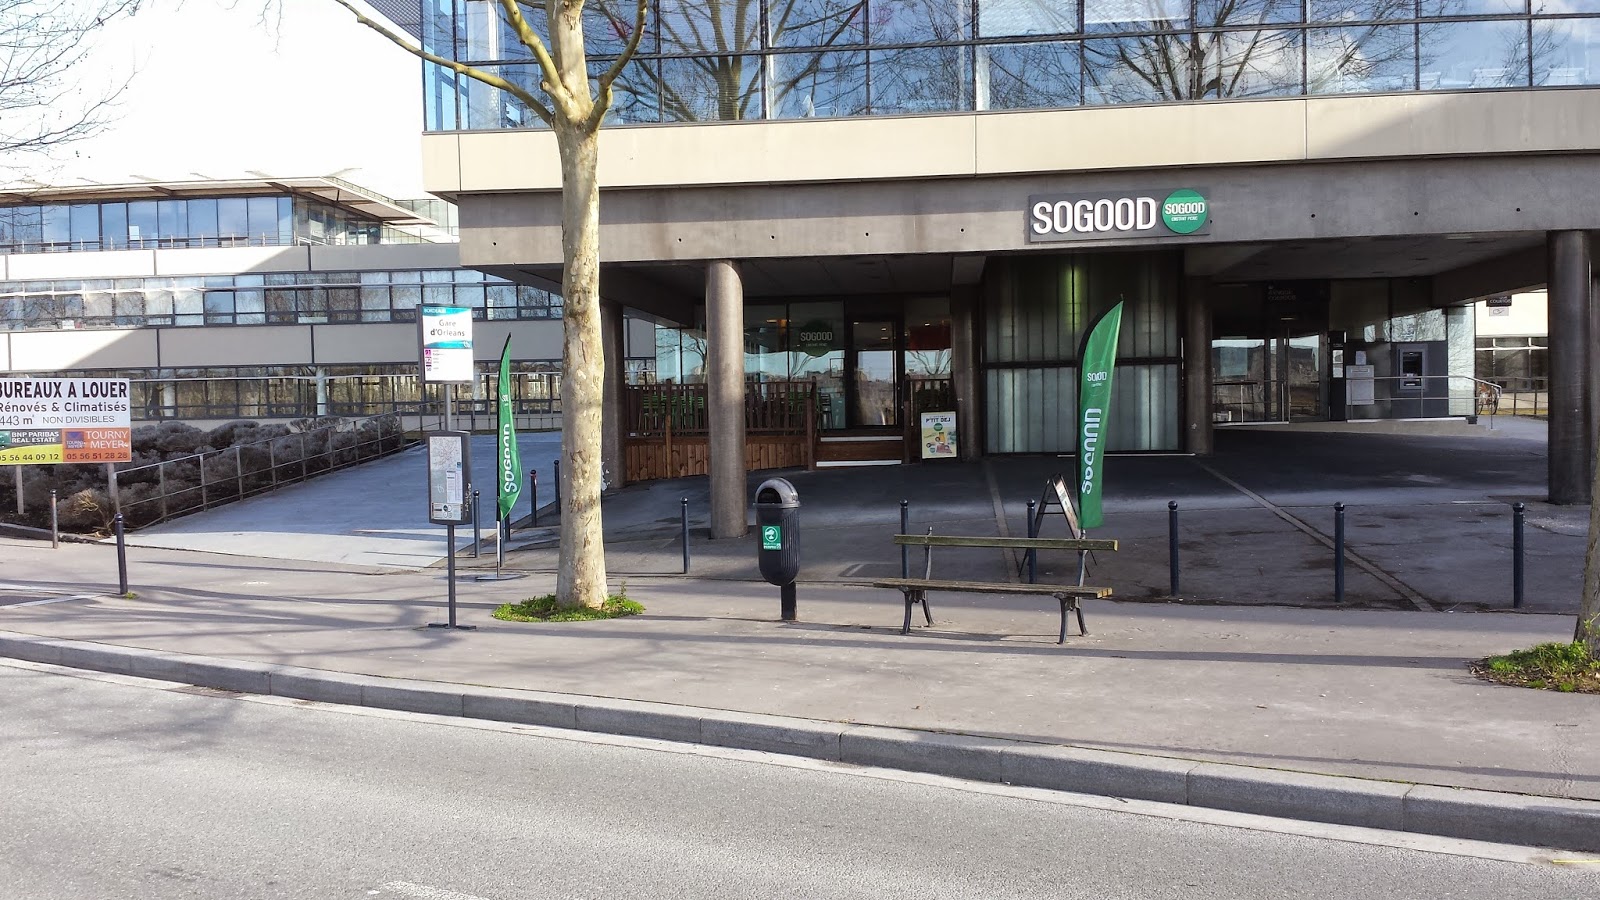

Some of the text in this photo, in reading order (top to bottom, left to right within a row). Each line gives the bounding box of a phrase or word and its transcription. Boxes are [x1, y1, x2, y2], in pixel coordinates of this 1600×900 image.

[1164, 202, 1206, 215] SOGOOD
[1032, 197, 1157, 234] SOGOOD
[438, 319, 457, 327] Gare
[800, 332, 833, 341] SOGOOD
[0, 381, 127, 398] UREAUX A LOUER
[51, 402, 60, 412] &
[64, 401, 127, 412] Climatisés
[42, 416, 63, 424] NON
[66, 415, 115, 423] DIVISIBLES
[86, 431, 128, 439] TOURNY
[90, 440, 123, 449] MEYER
